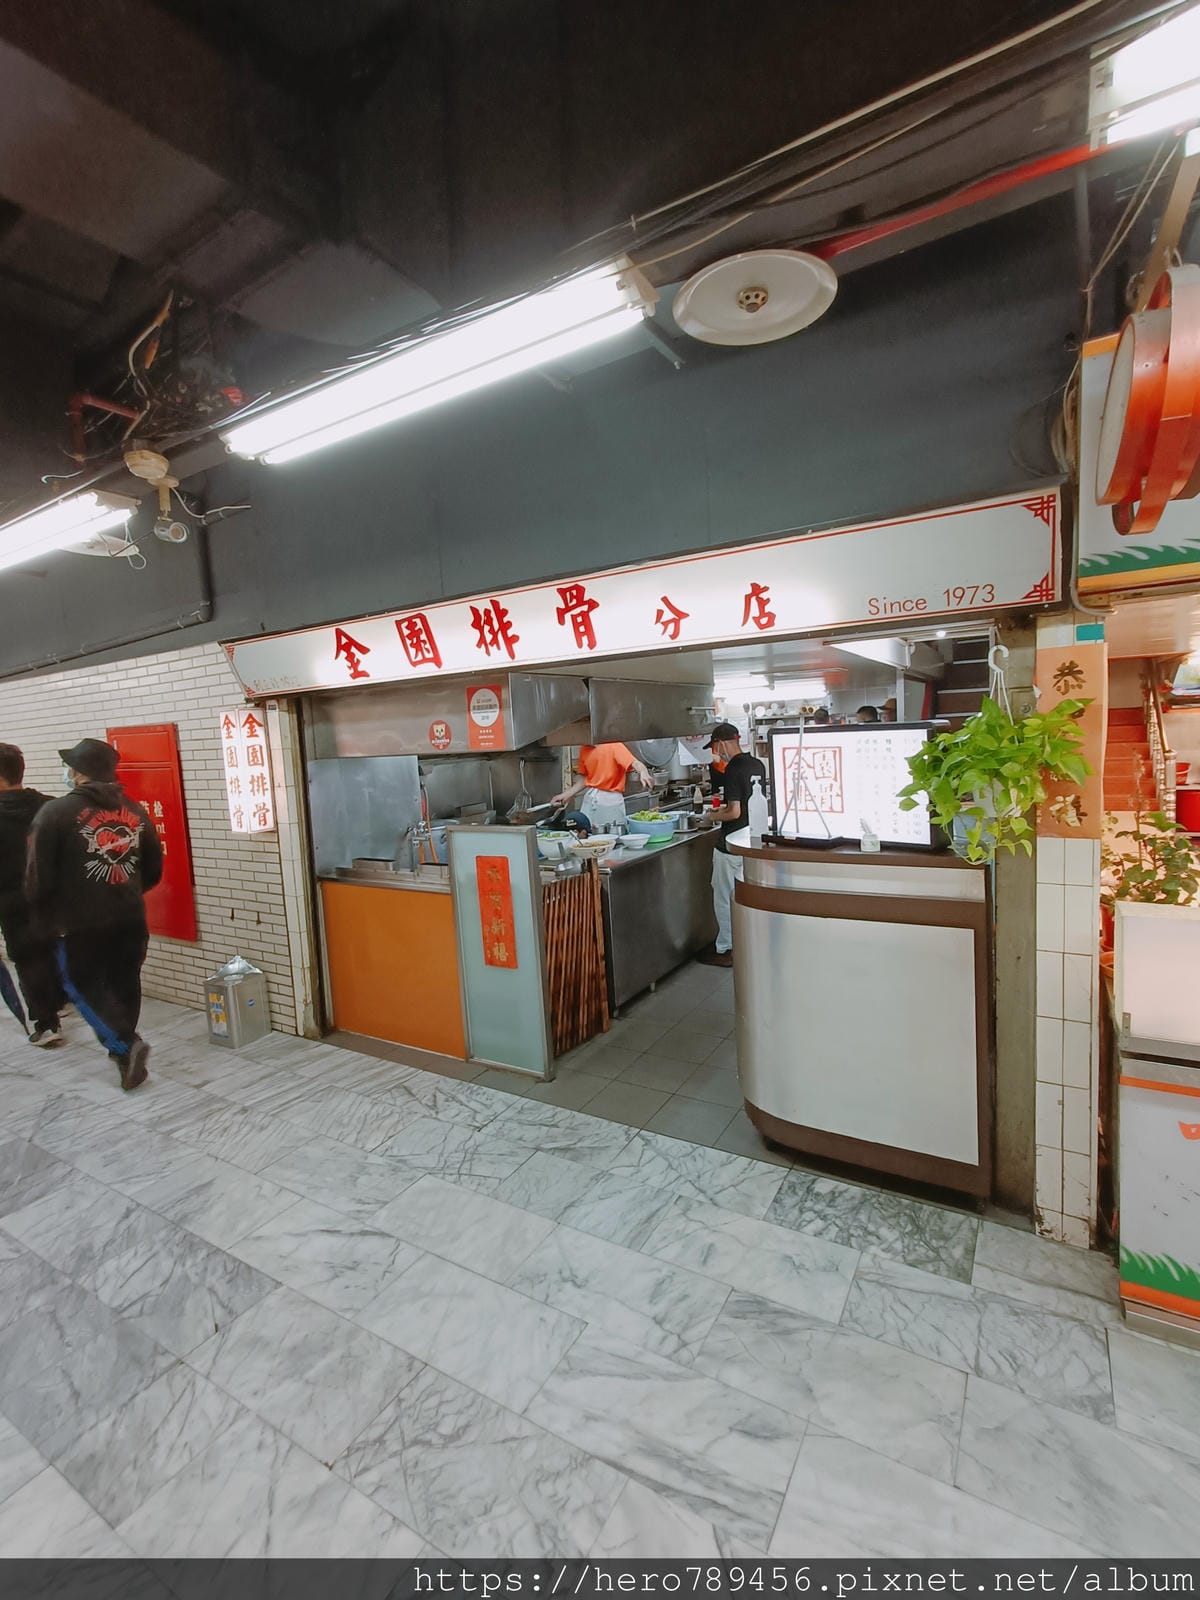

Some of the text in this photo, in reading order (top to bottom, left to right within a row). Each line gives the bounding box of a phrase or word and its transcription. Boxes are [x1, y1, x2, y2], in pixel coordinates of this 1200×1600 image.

[868, 583, 996, 616] Since 1973
[222, 713, 245, 830] 金園排骨
[241, 712, 271, 828] 金園排骨
